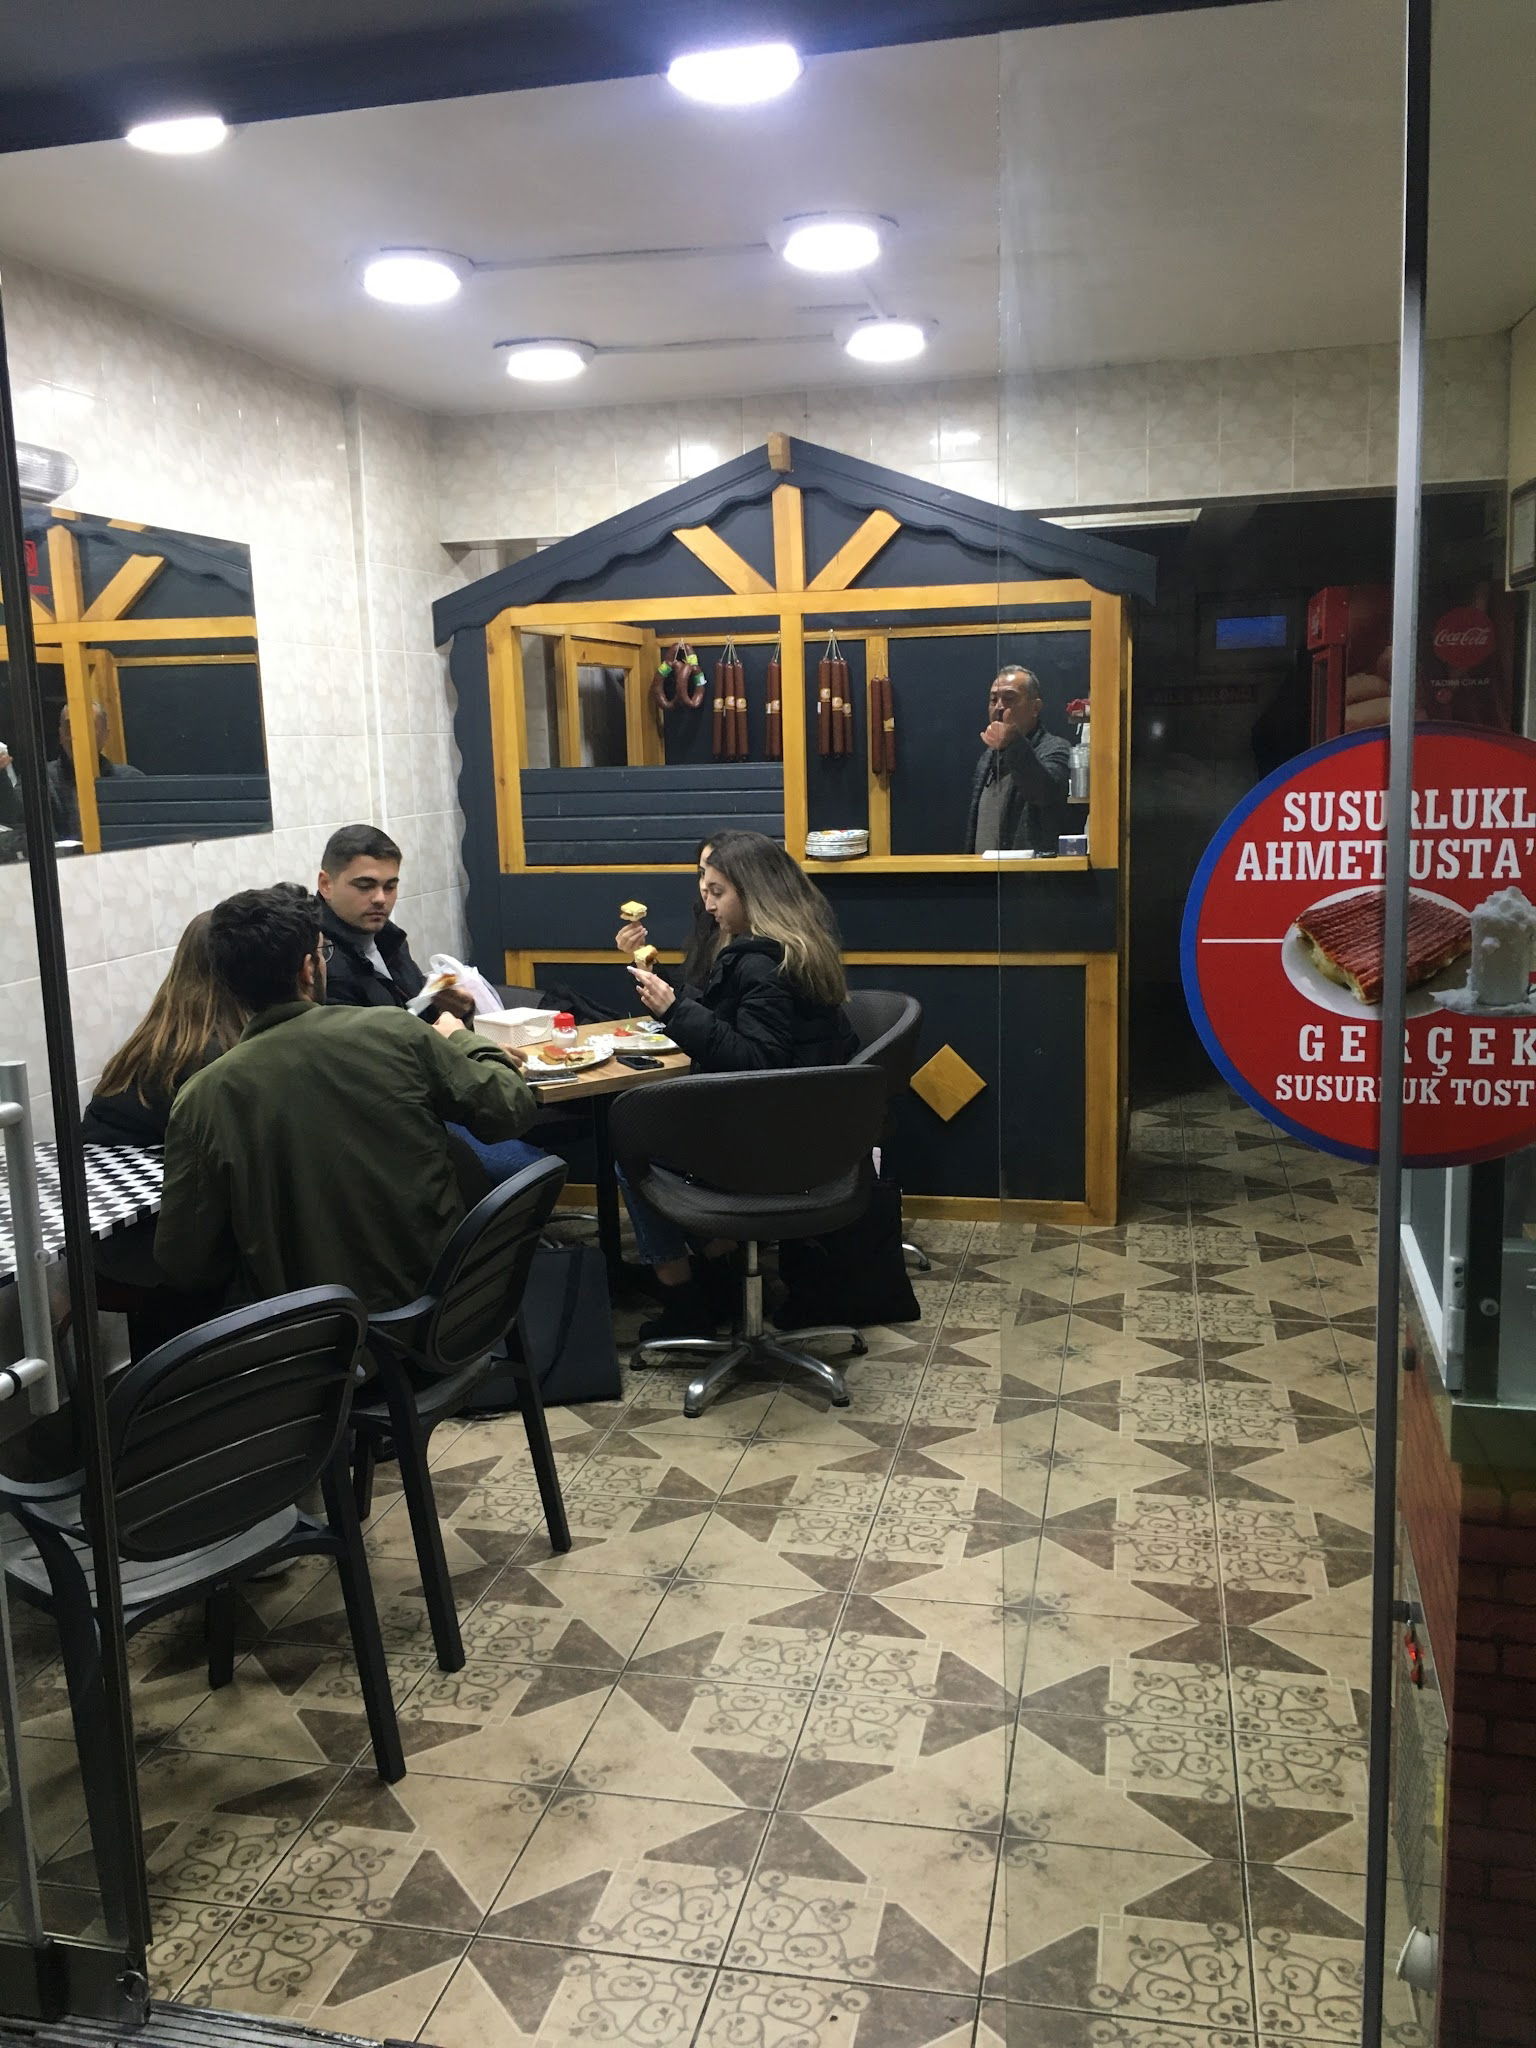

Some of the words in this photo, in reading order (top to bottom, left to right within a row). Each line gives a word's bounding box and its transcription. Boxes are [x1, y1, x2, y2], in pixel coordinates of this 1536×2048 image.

[1235, 840, 1387, 881] AHMET
[1408, 838, 1535, 880] USTA'
[1276, 1075, 1440, 1104] SUSURUK
[1450, 1078, 1535, 1107] TOST
